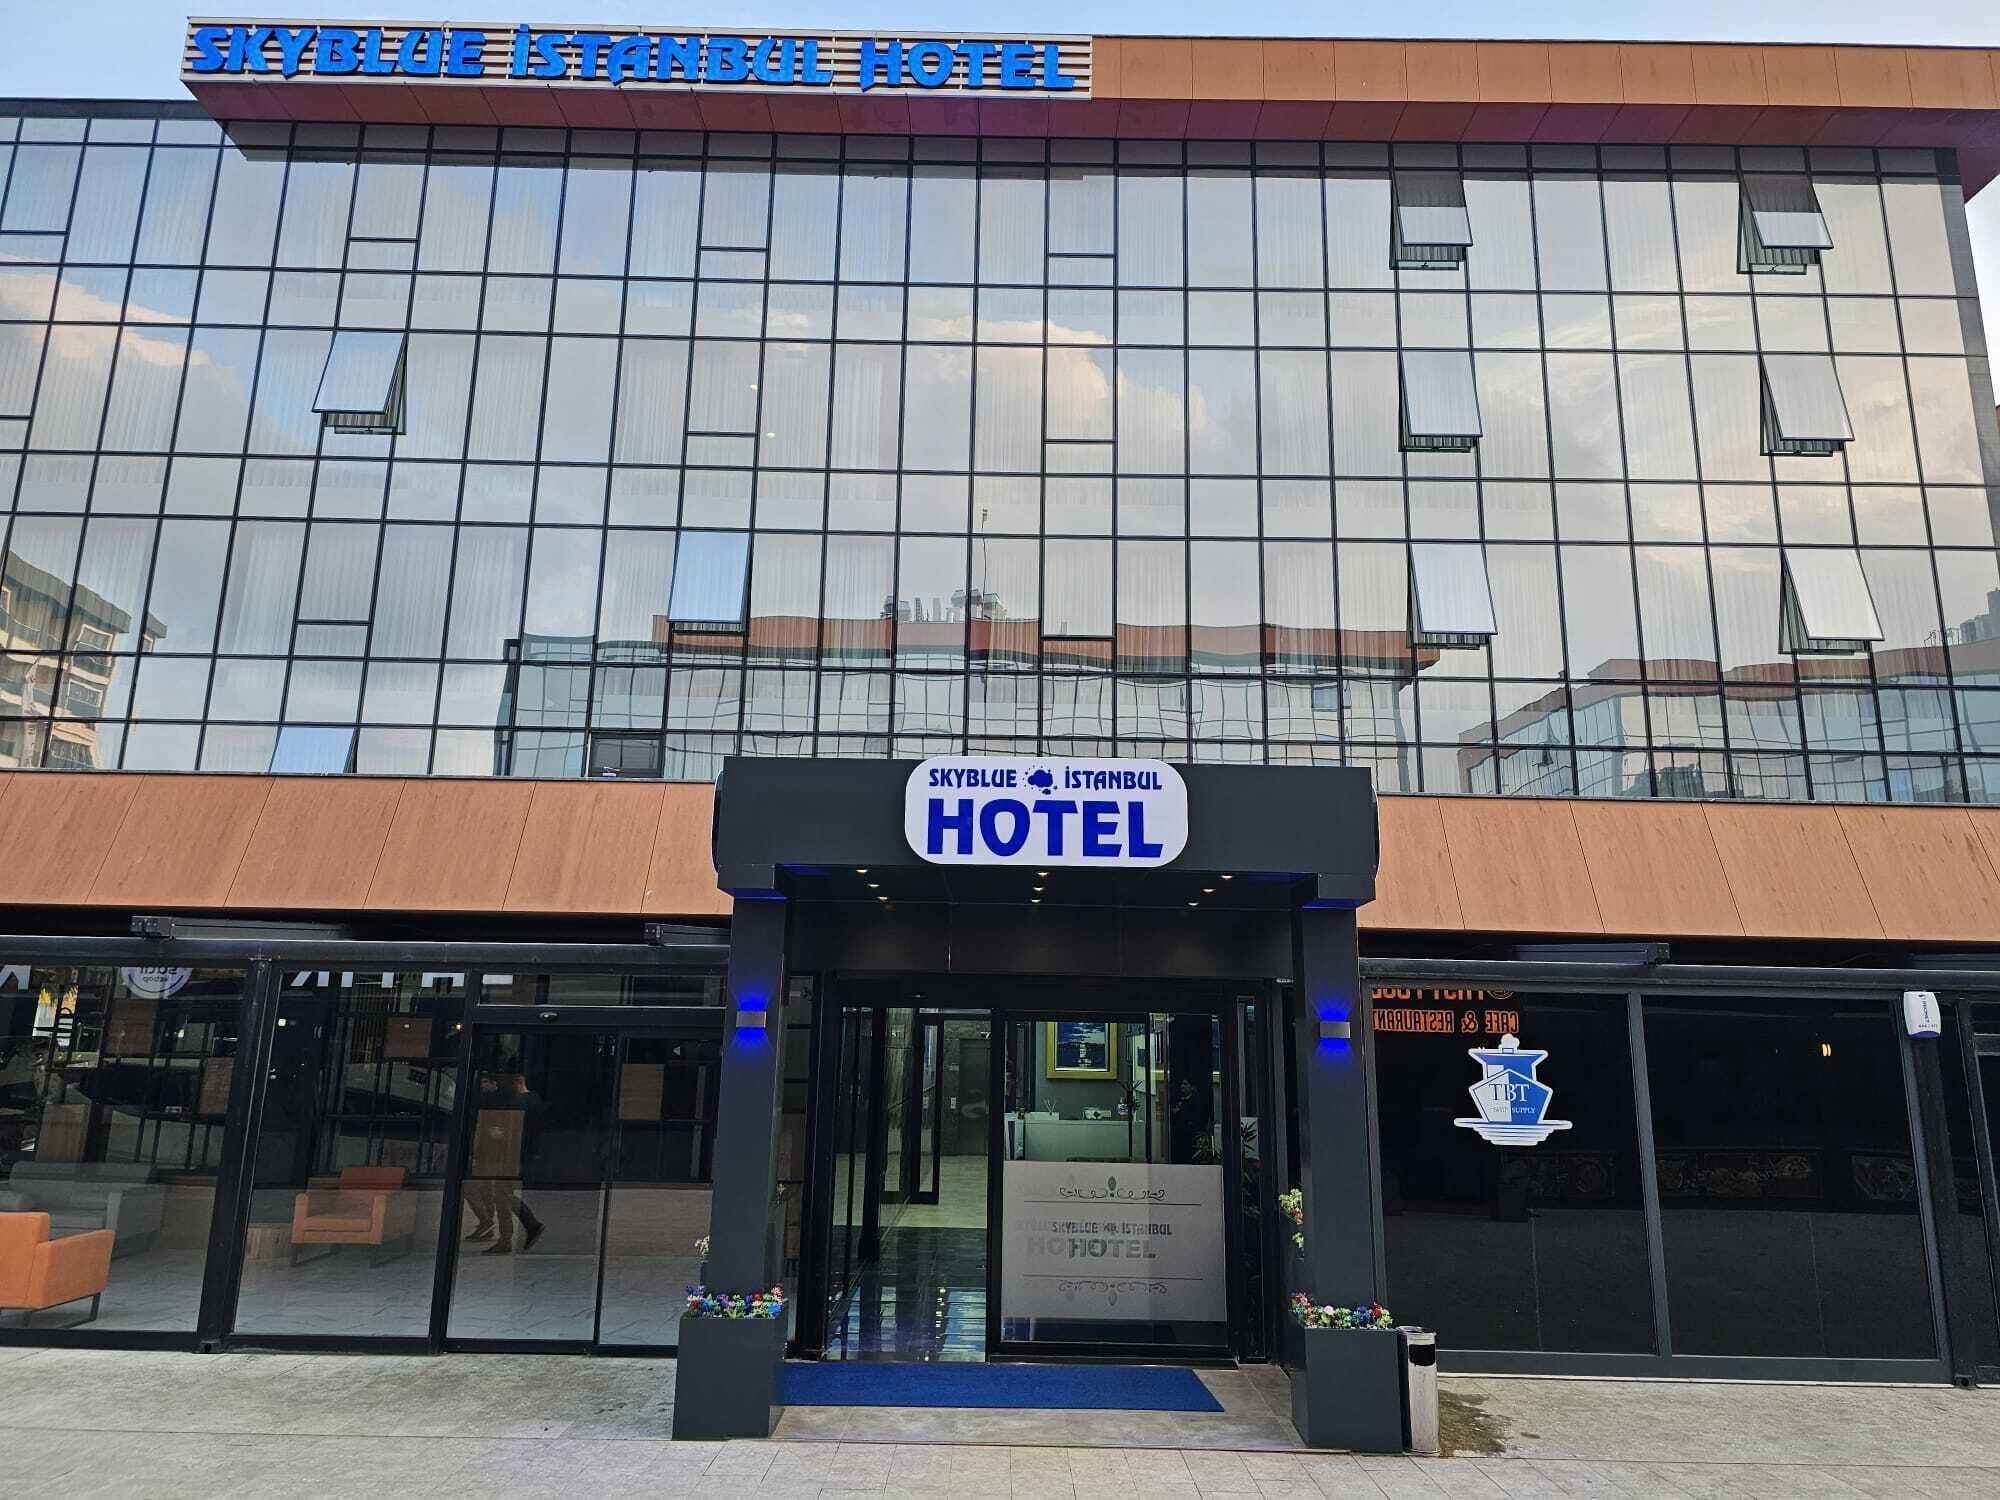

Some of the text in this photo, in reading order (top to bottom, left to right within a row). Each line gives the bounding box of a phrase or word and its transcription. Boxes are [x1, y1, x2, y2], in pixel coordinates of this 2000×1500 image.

[191, 24, 1076, 92] SKYBLUE İSTANBUL HOTEL
[928, 766, 1163, 791] SKYBLUE İSTANBUL
[927, 798, 1164, 858] HOTEL
[1489, 1083, 1529, 1102] TBT
[1067, 1237, 1157, 1260] HOTEL
